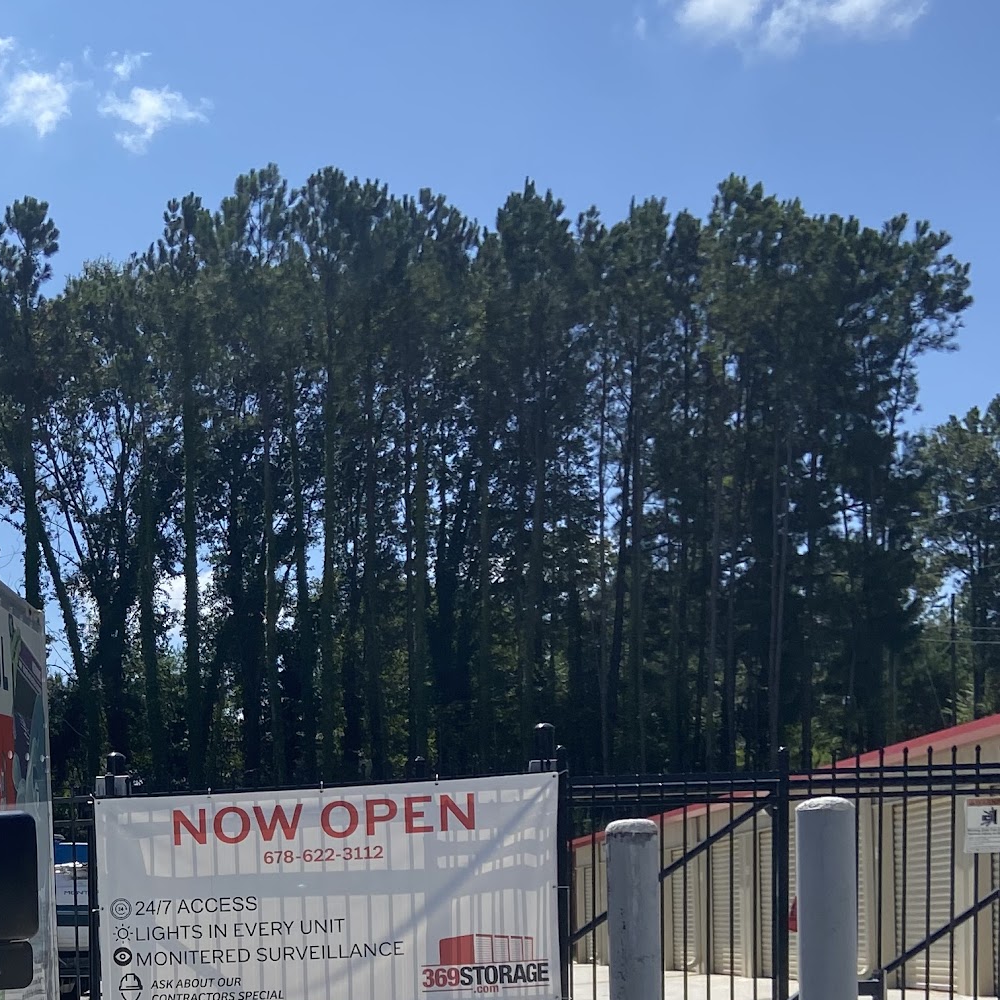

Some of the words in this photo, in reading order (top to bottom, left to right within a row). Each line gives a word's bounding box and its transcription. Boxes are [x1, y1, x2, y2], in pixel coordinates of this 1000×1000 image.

[172, 803, 303, 846] NOW
[320, 793, 476, 839] OPEN
[263, 846, 384, 865] 678-622-3112
[135, 899, 172, 916] 24/7
[177, 896, 258, 915] ACCESS
[135, 924, 203, 942] LIGHTS
[208, 923, 227, 939] IN
[234, 920, 294, 938] EVERY
[300, 918, 345, 935] UNIT
[136, 948, 251, 967] MONITERED
[256, 940, 405, 963] SURVEILLANCE
[151, 979, 174, 990] ASK
[175, 977, 215, 989] ABOUT
[217, 977, 242, 988] OUR
[473, 984, 499, 994] .com
[237, 990, 285, 1000] SPECIAL
